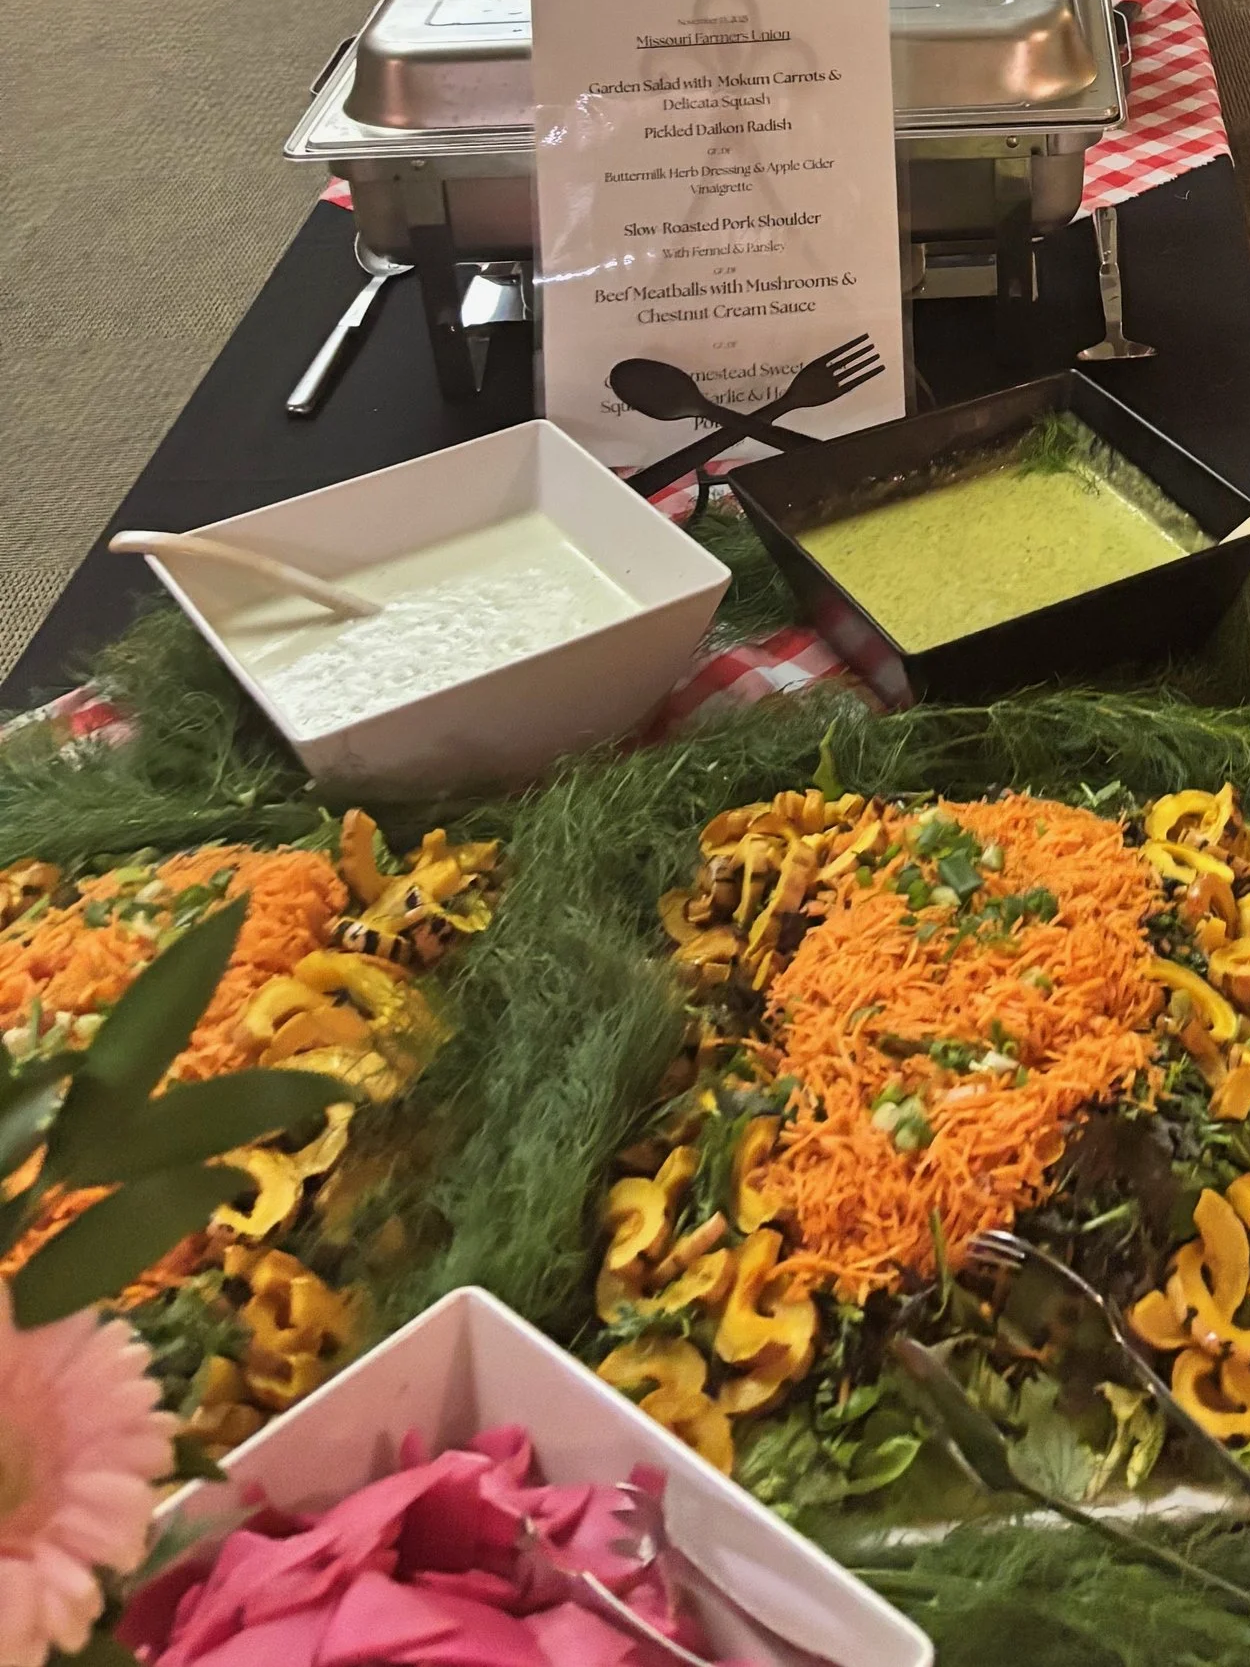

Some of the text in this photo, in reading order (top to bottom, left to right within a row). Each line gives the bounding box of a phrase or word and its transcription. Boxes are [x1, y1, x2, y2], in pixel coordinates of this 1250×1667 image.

[636, 30, 791, 48] Missouri Farmers Union
[589, 69, 842, 94] Garden Salad with Mokum Carrots &
[663, 93, 771, 111] Delicata Squash
[644, 118, 792, 139] Pickled Daikon Radish
[604, 158, 835, 183] Buttermilk Herb Dressing & Apple Cider
[690, 182, 753, 196] Vinaigrette
[624, 212, 821, 236] Slow Roasted Pork Shoulder
[662, 240, 785, 259] With Fennel & Parsley
[595, 271, 857, 303] Beef Meatballs with Mushrooms &
[638, 301, 816, 324] Chestnut Cream Sauce
[703, 387, 745, 405] arlic
[748, 387, 764, 402] &
